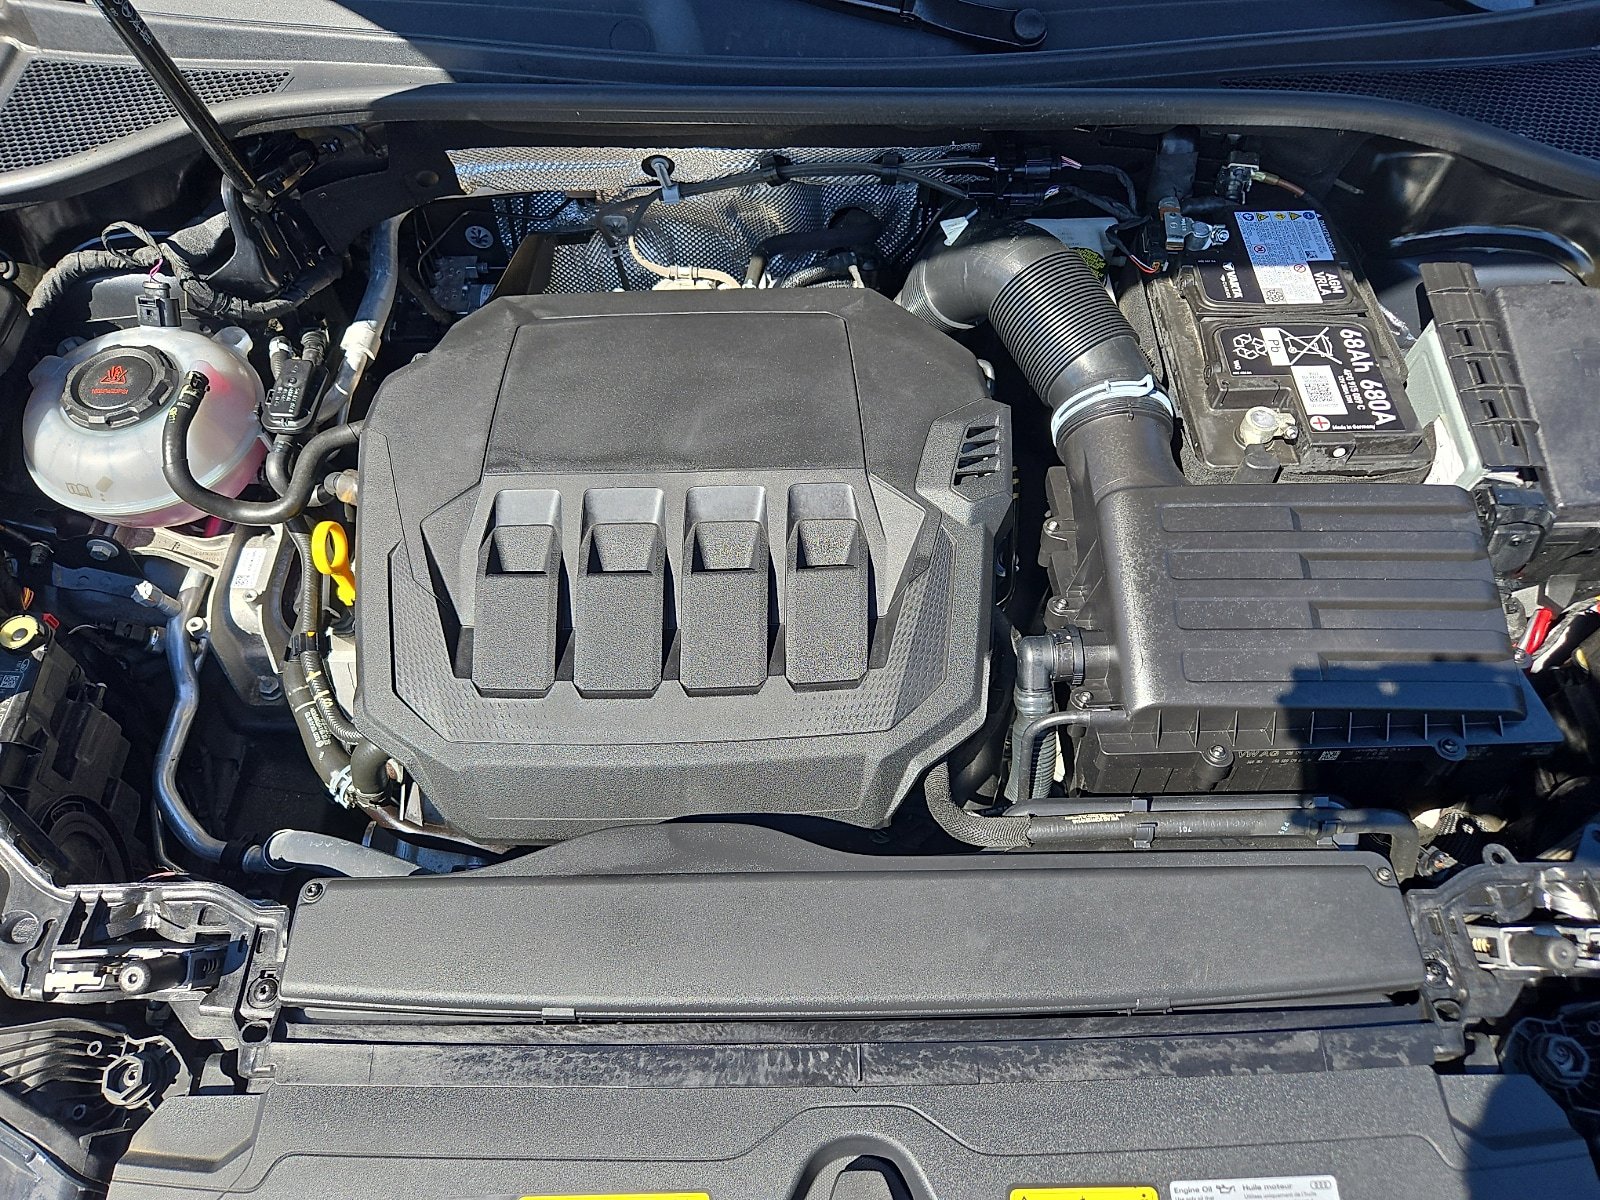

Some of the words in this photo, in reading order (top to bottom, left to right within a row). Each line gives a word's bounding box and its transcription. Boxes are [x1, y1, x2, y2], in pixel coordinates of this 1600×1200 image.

[1226, 271, 1244, 299] VARTA
[1314, 271, 1331, 296] VRLA
[1325, 272, 1345, 294] AGM
[1268, 339, 1281, 353] Pb
[1340, 328, 1374, 373] 68Ah
[1359, 379, 1397, 426] 680A
[1173, 1186, 1200, 1195] Engine
[1201, 1185, 1213, 1193] Oil
[1263, 1183, 1292, 1191] moteur
